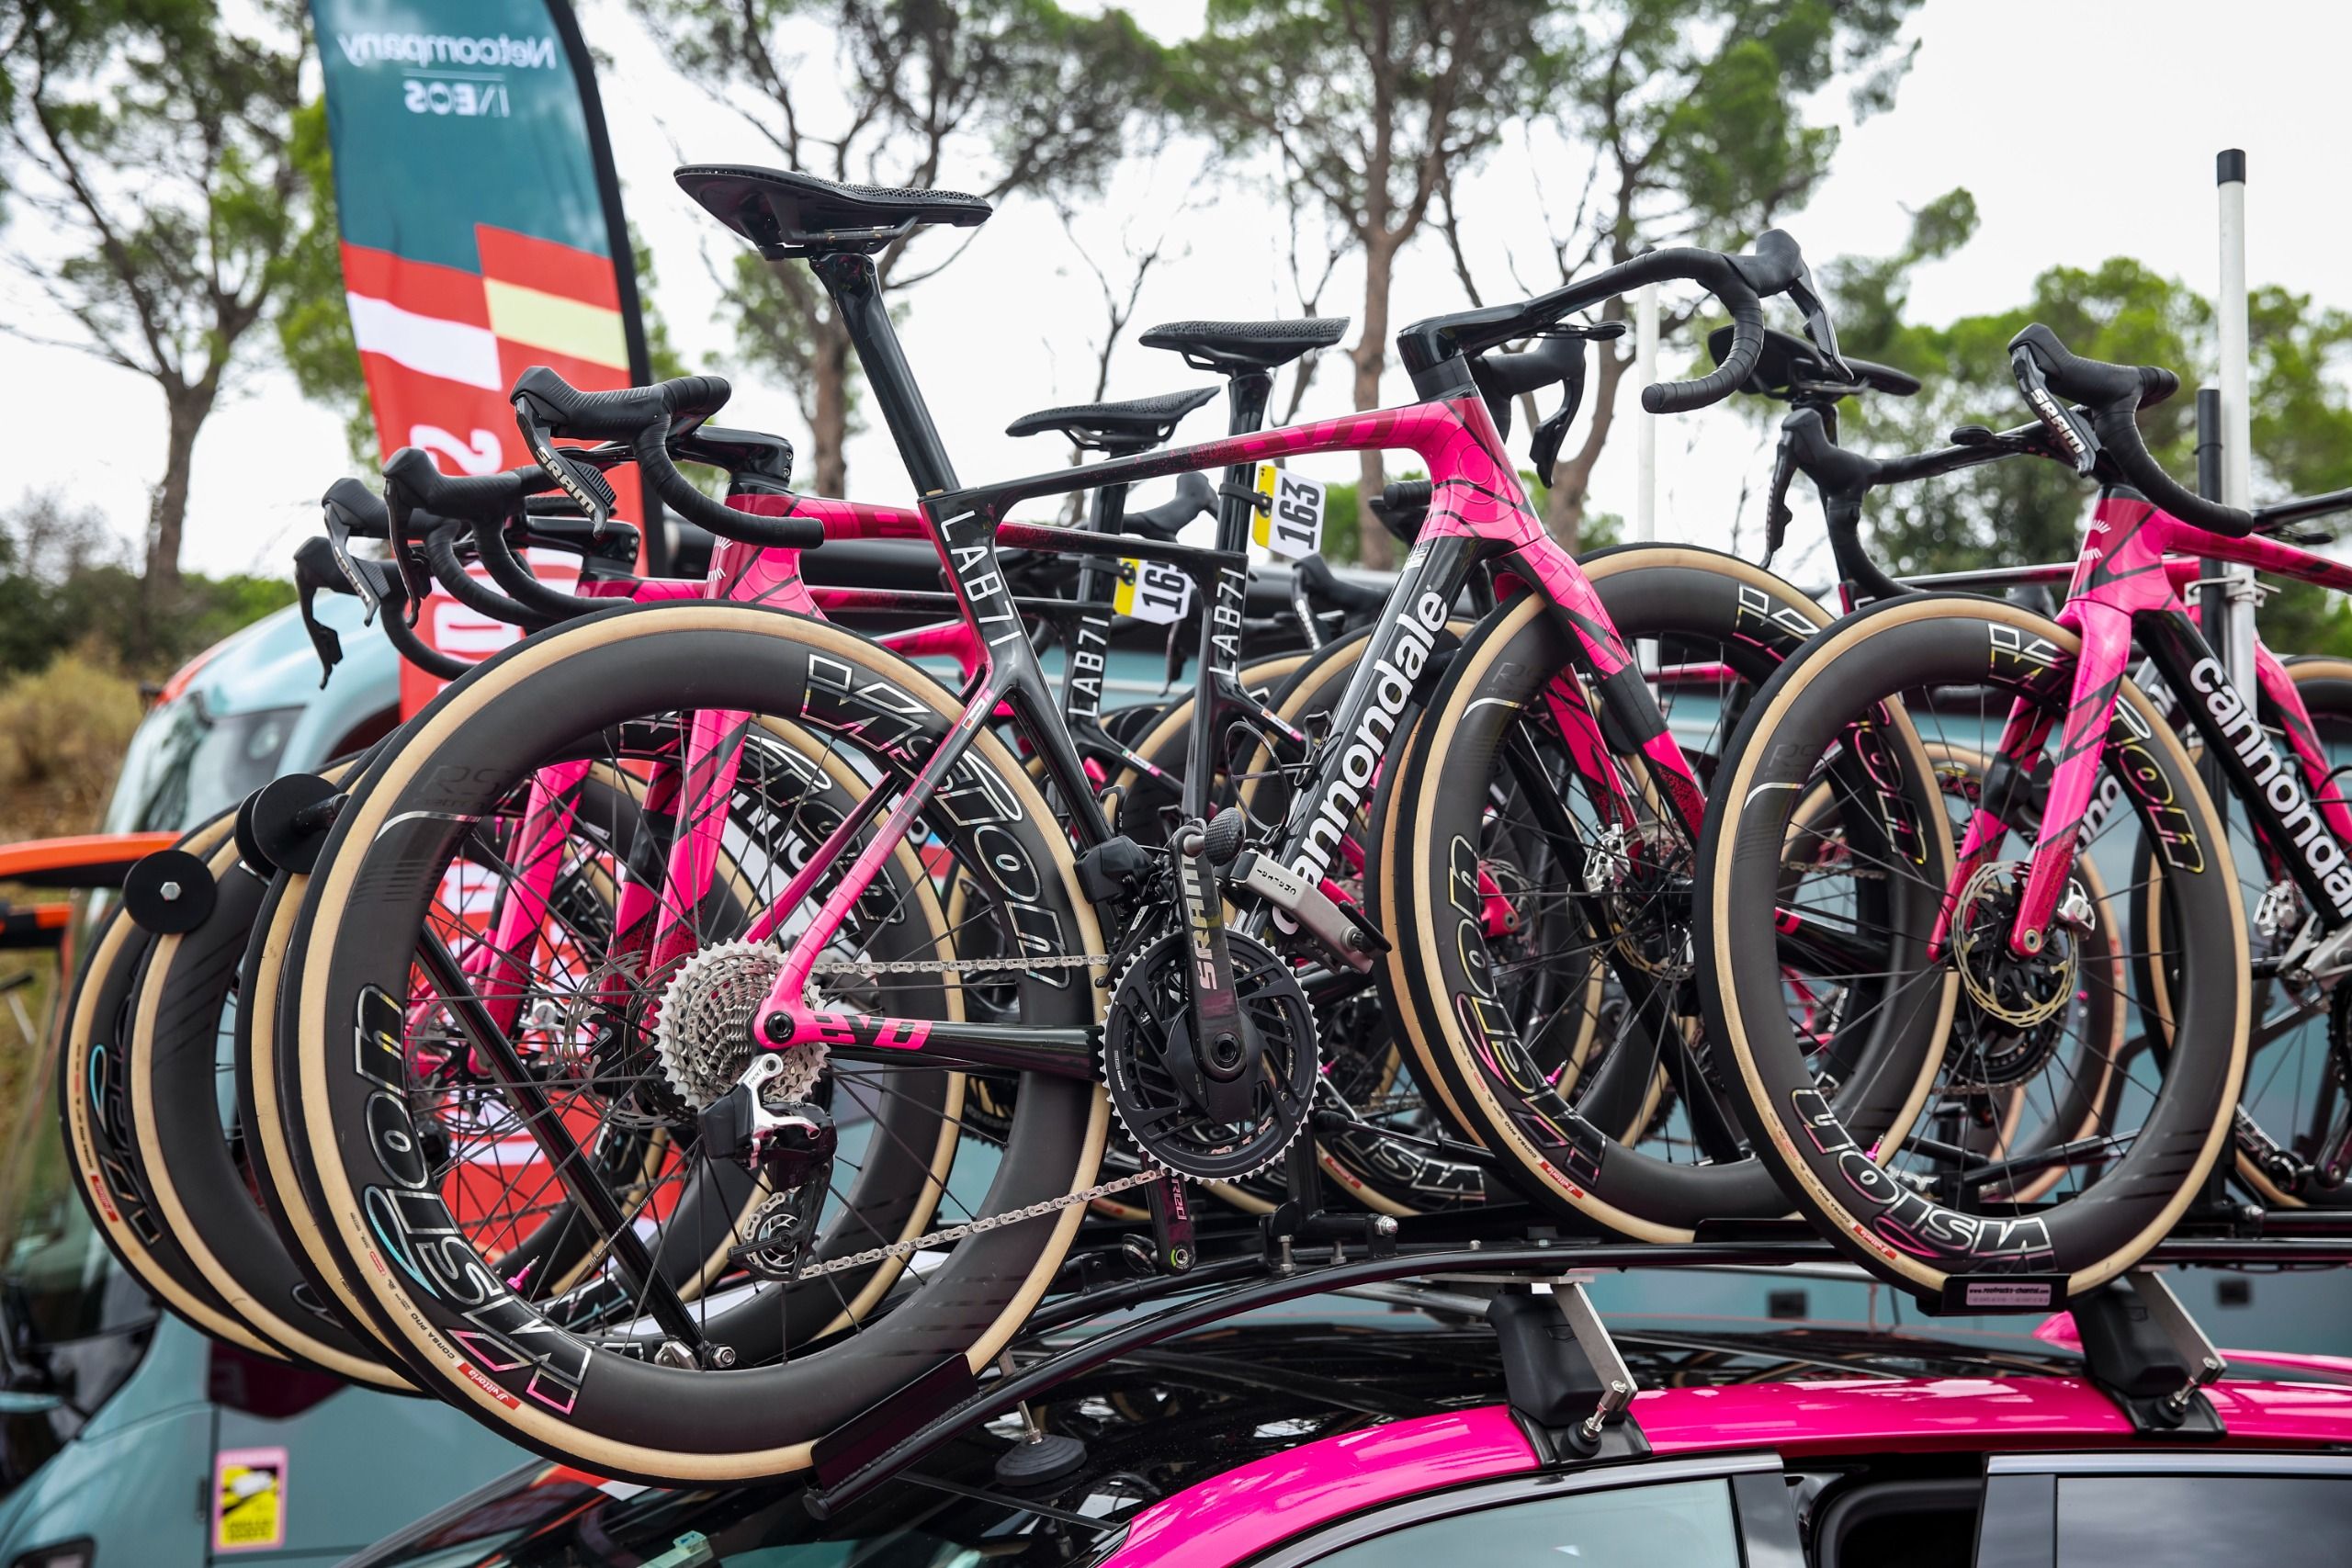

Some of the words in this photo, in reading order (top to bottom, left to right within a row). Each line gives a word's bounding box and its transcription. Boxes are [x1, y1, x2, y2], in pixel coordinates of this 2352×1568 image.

[2030, 388, 2086, 455] SRAM
[536, 446, 597, 514] SRAM
[1277, 477, 1320, 550] 163
[941, 510, 1023, 647] LAB71
[1142, 560, 1187, 615] 16
[1209, 567, 1247, 677] LAB71
[1069, 615, 1110, 716] LAB71
[1181, 852, 1218, 990] SRAM
[1505, 1121, 1517, 1136] PRO
[1517, 1136, 1537, 1159] CORSA
[1817, 1188, 1830, 1203] PRO
[411, 1312, 428, 1331] PRO
[427, 1332, 456, 1360] CORSA
[468, 1369, 501, 1396] vittoria
